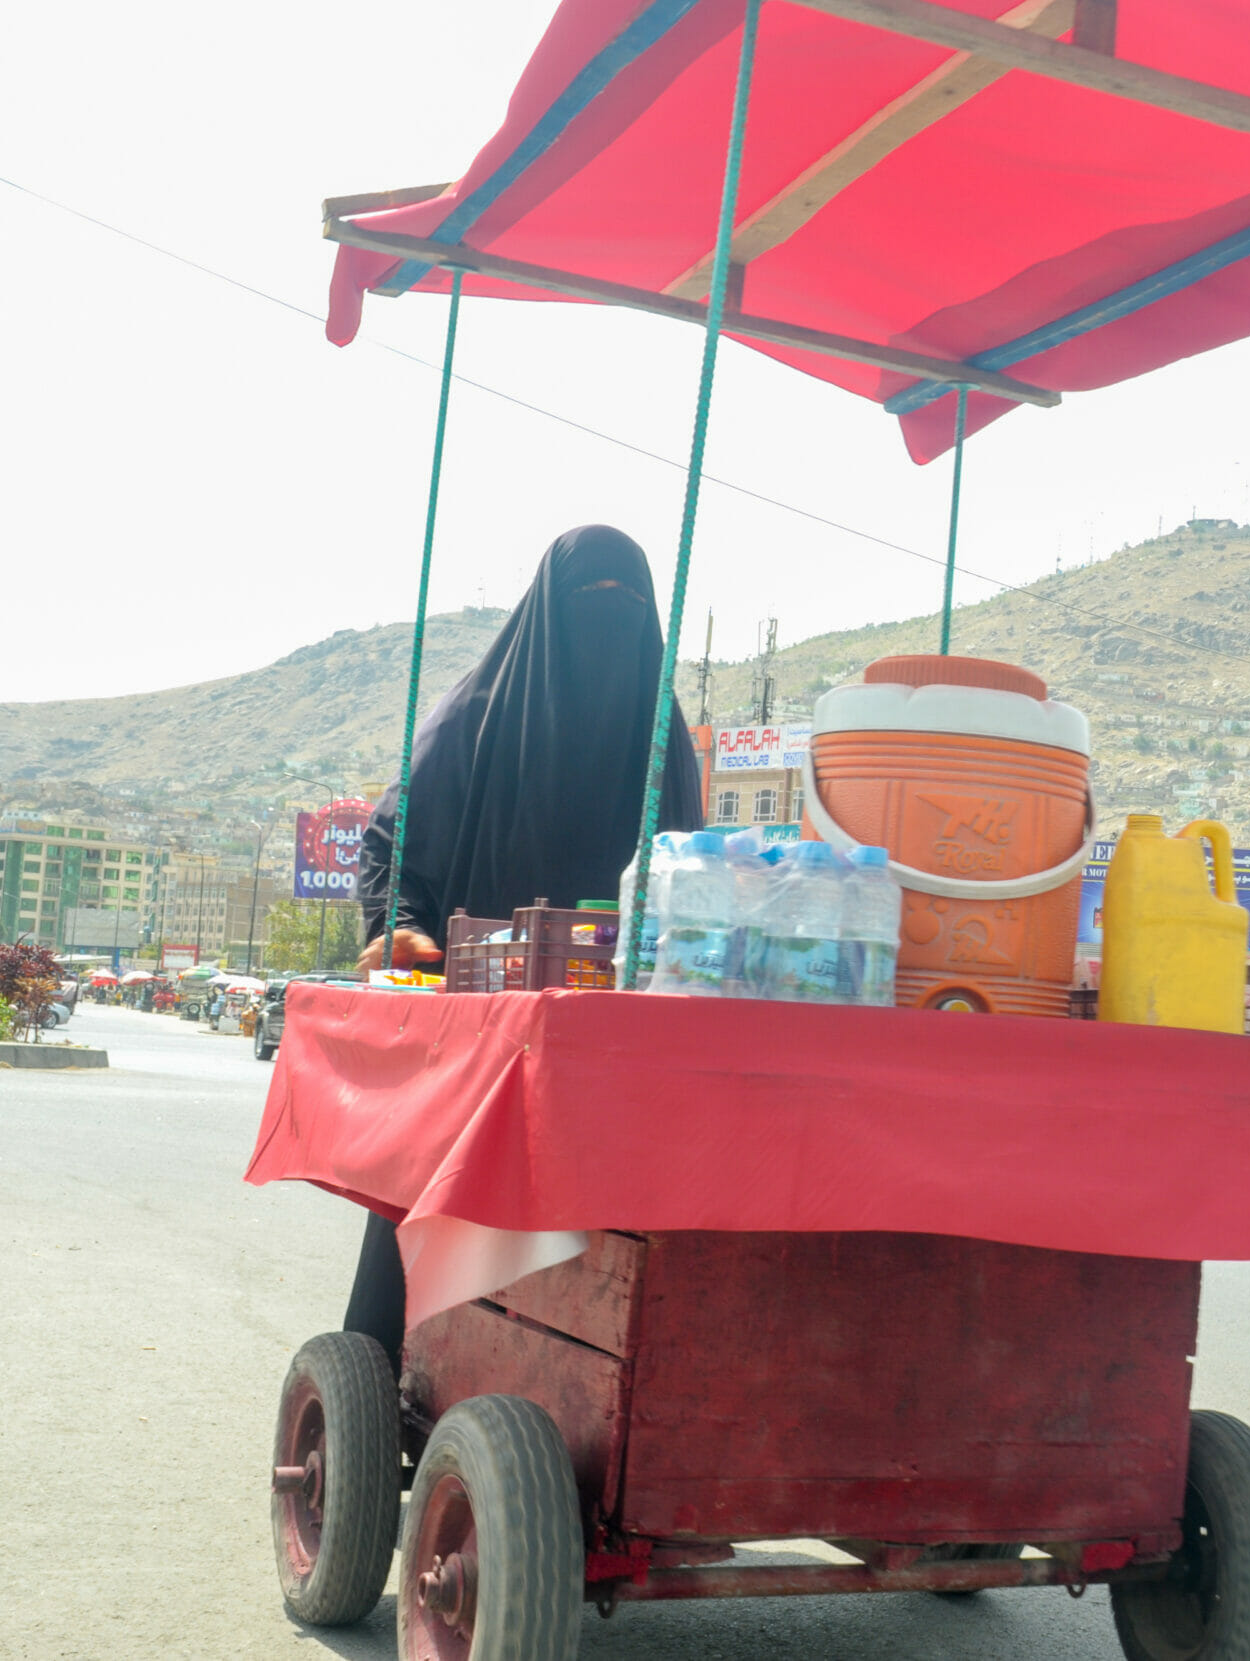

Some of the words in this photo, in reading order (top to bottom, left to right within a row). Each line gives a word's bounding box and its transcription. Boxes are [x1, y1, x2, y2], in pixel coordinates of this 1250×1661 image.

[719, 728, 781, 752] ALFALAH
[721, 755, 752, 767] MEDICAL
[753, 754, 769, 766] LAB
